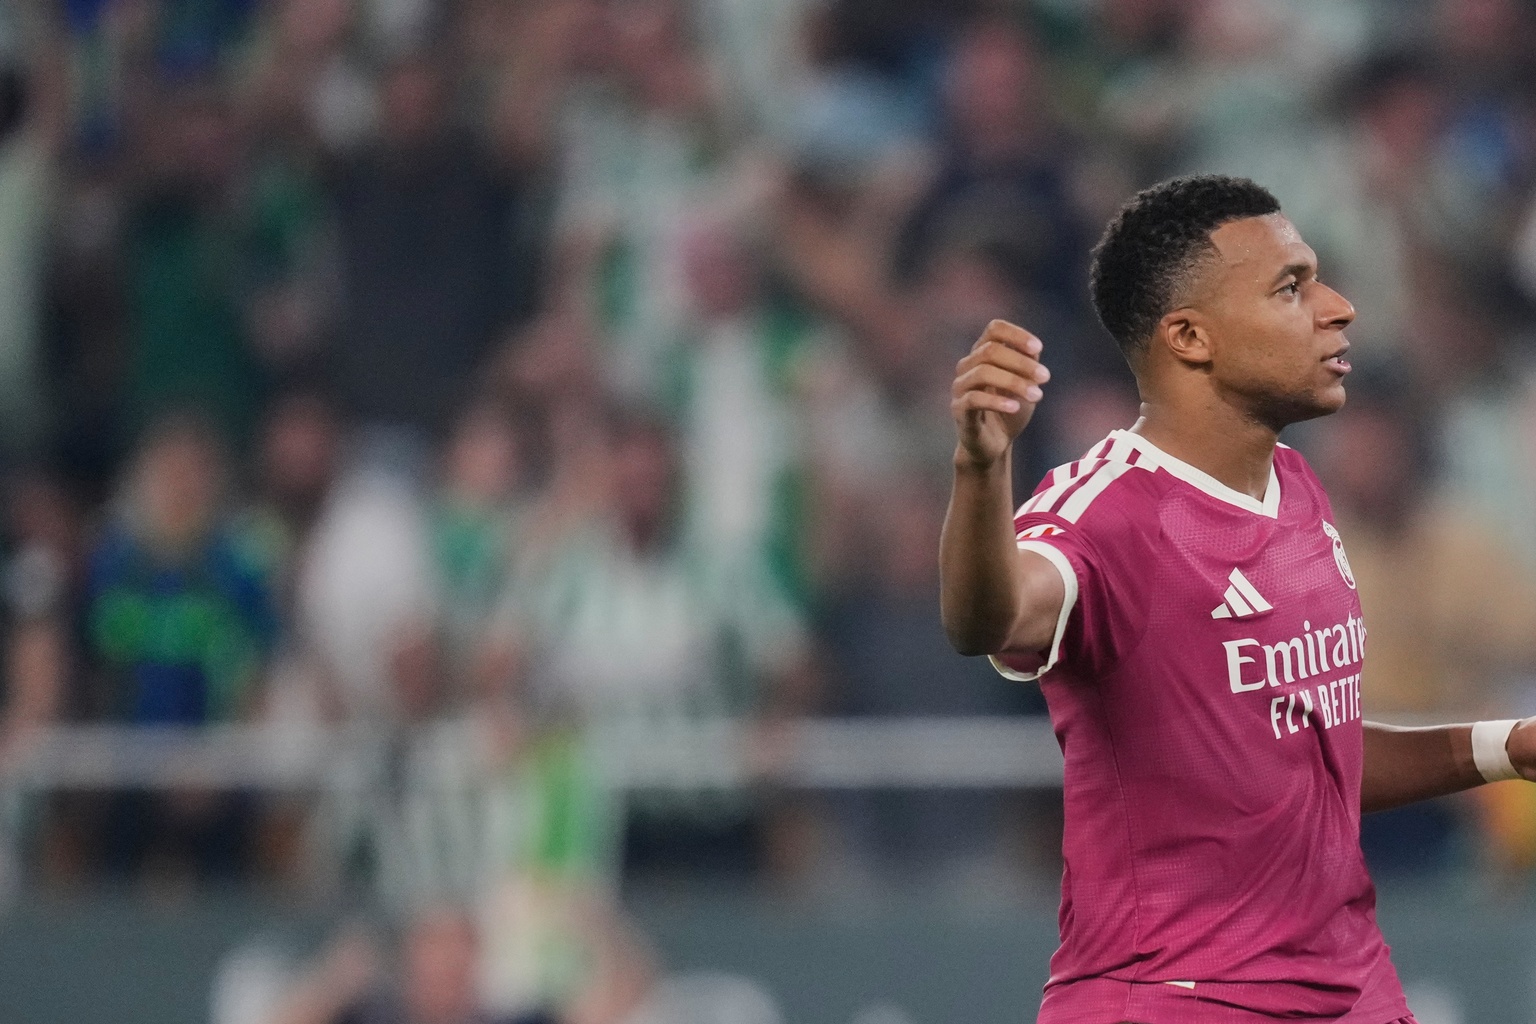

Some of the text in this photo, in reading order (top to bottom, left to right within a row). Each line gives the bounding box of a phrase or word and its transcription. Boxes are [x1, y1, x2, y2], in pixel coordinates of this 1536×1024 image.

[1222, 611, 1368, 694] Emirate
[1270, 672, 1361, 740] FLY BETTE
